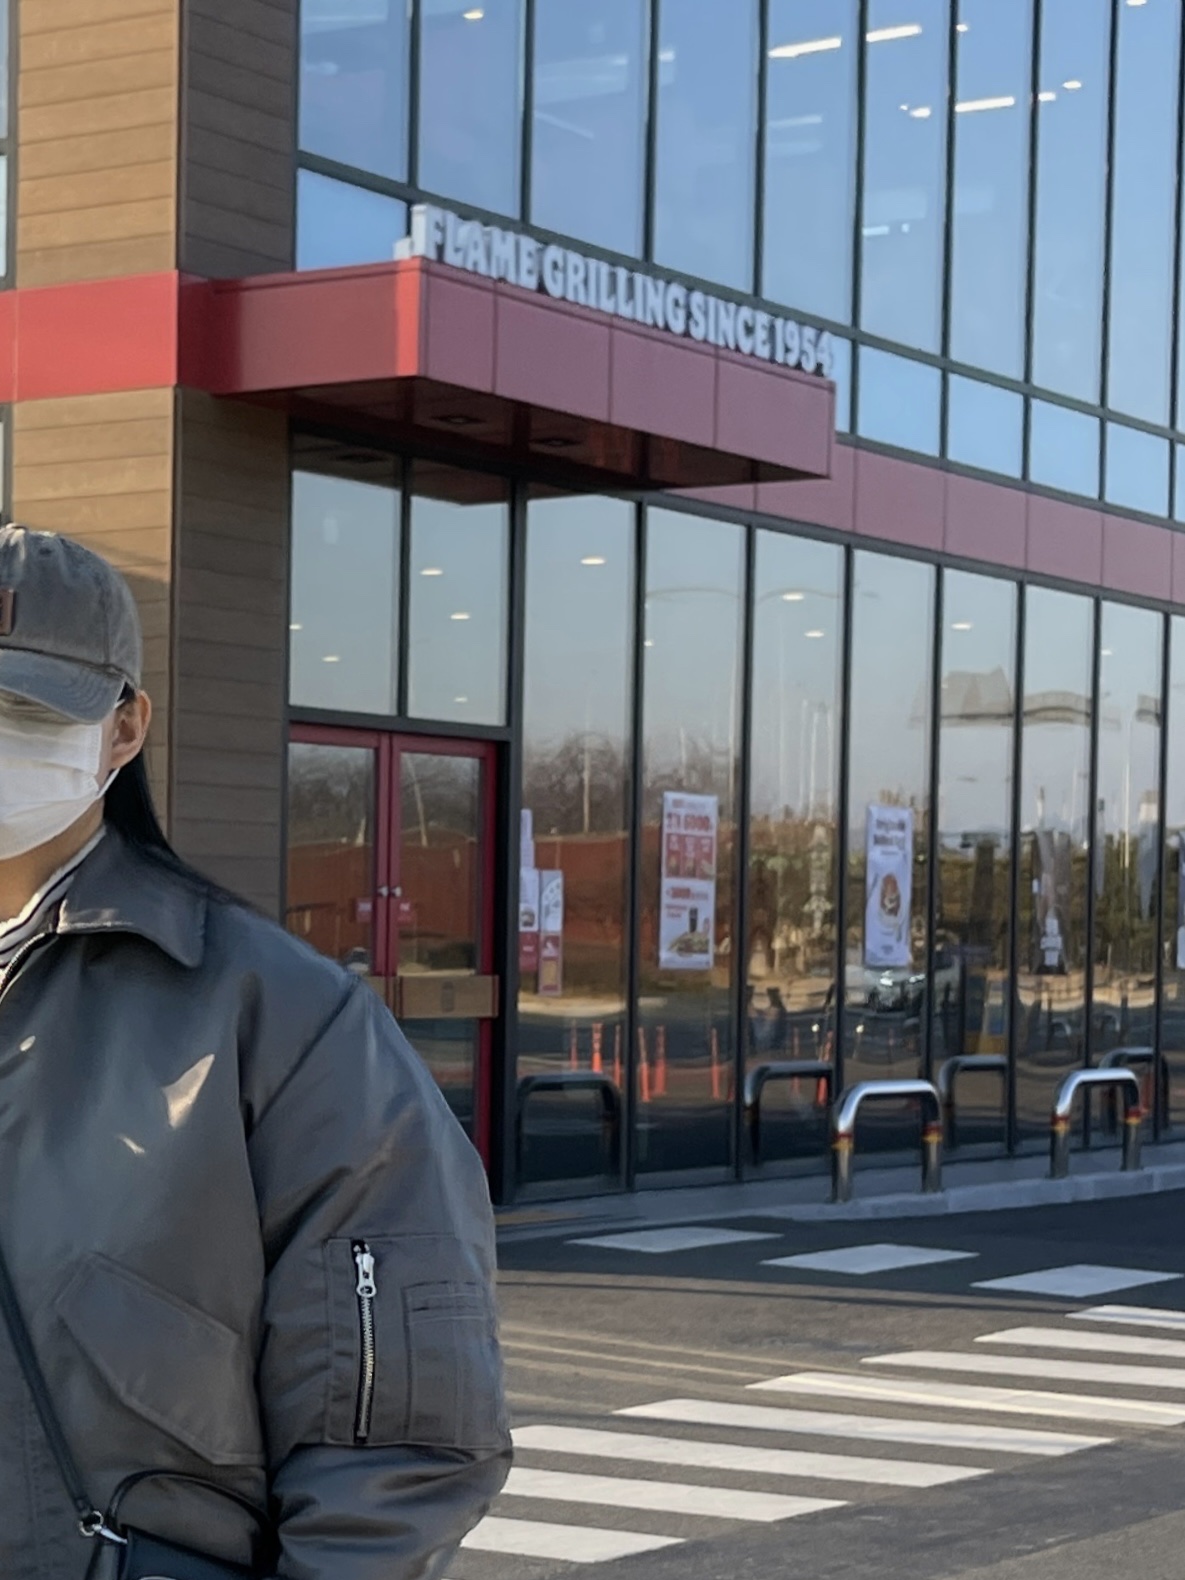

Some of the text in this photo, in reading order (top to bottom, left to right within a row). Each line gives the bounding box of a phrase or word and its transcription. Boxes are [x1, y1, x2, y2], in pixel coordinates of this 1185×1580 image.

[420, 204, 834, 377] FLAME GRILLING SINCE 1954
